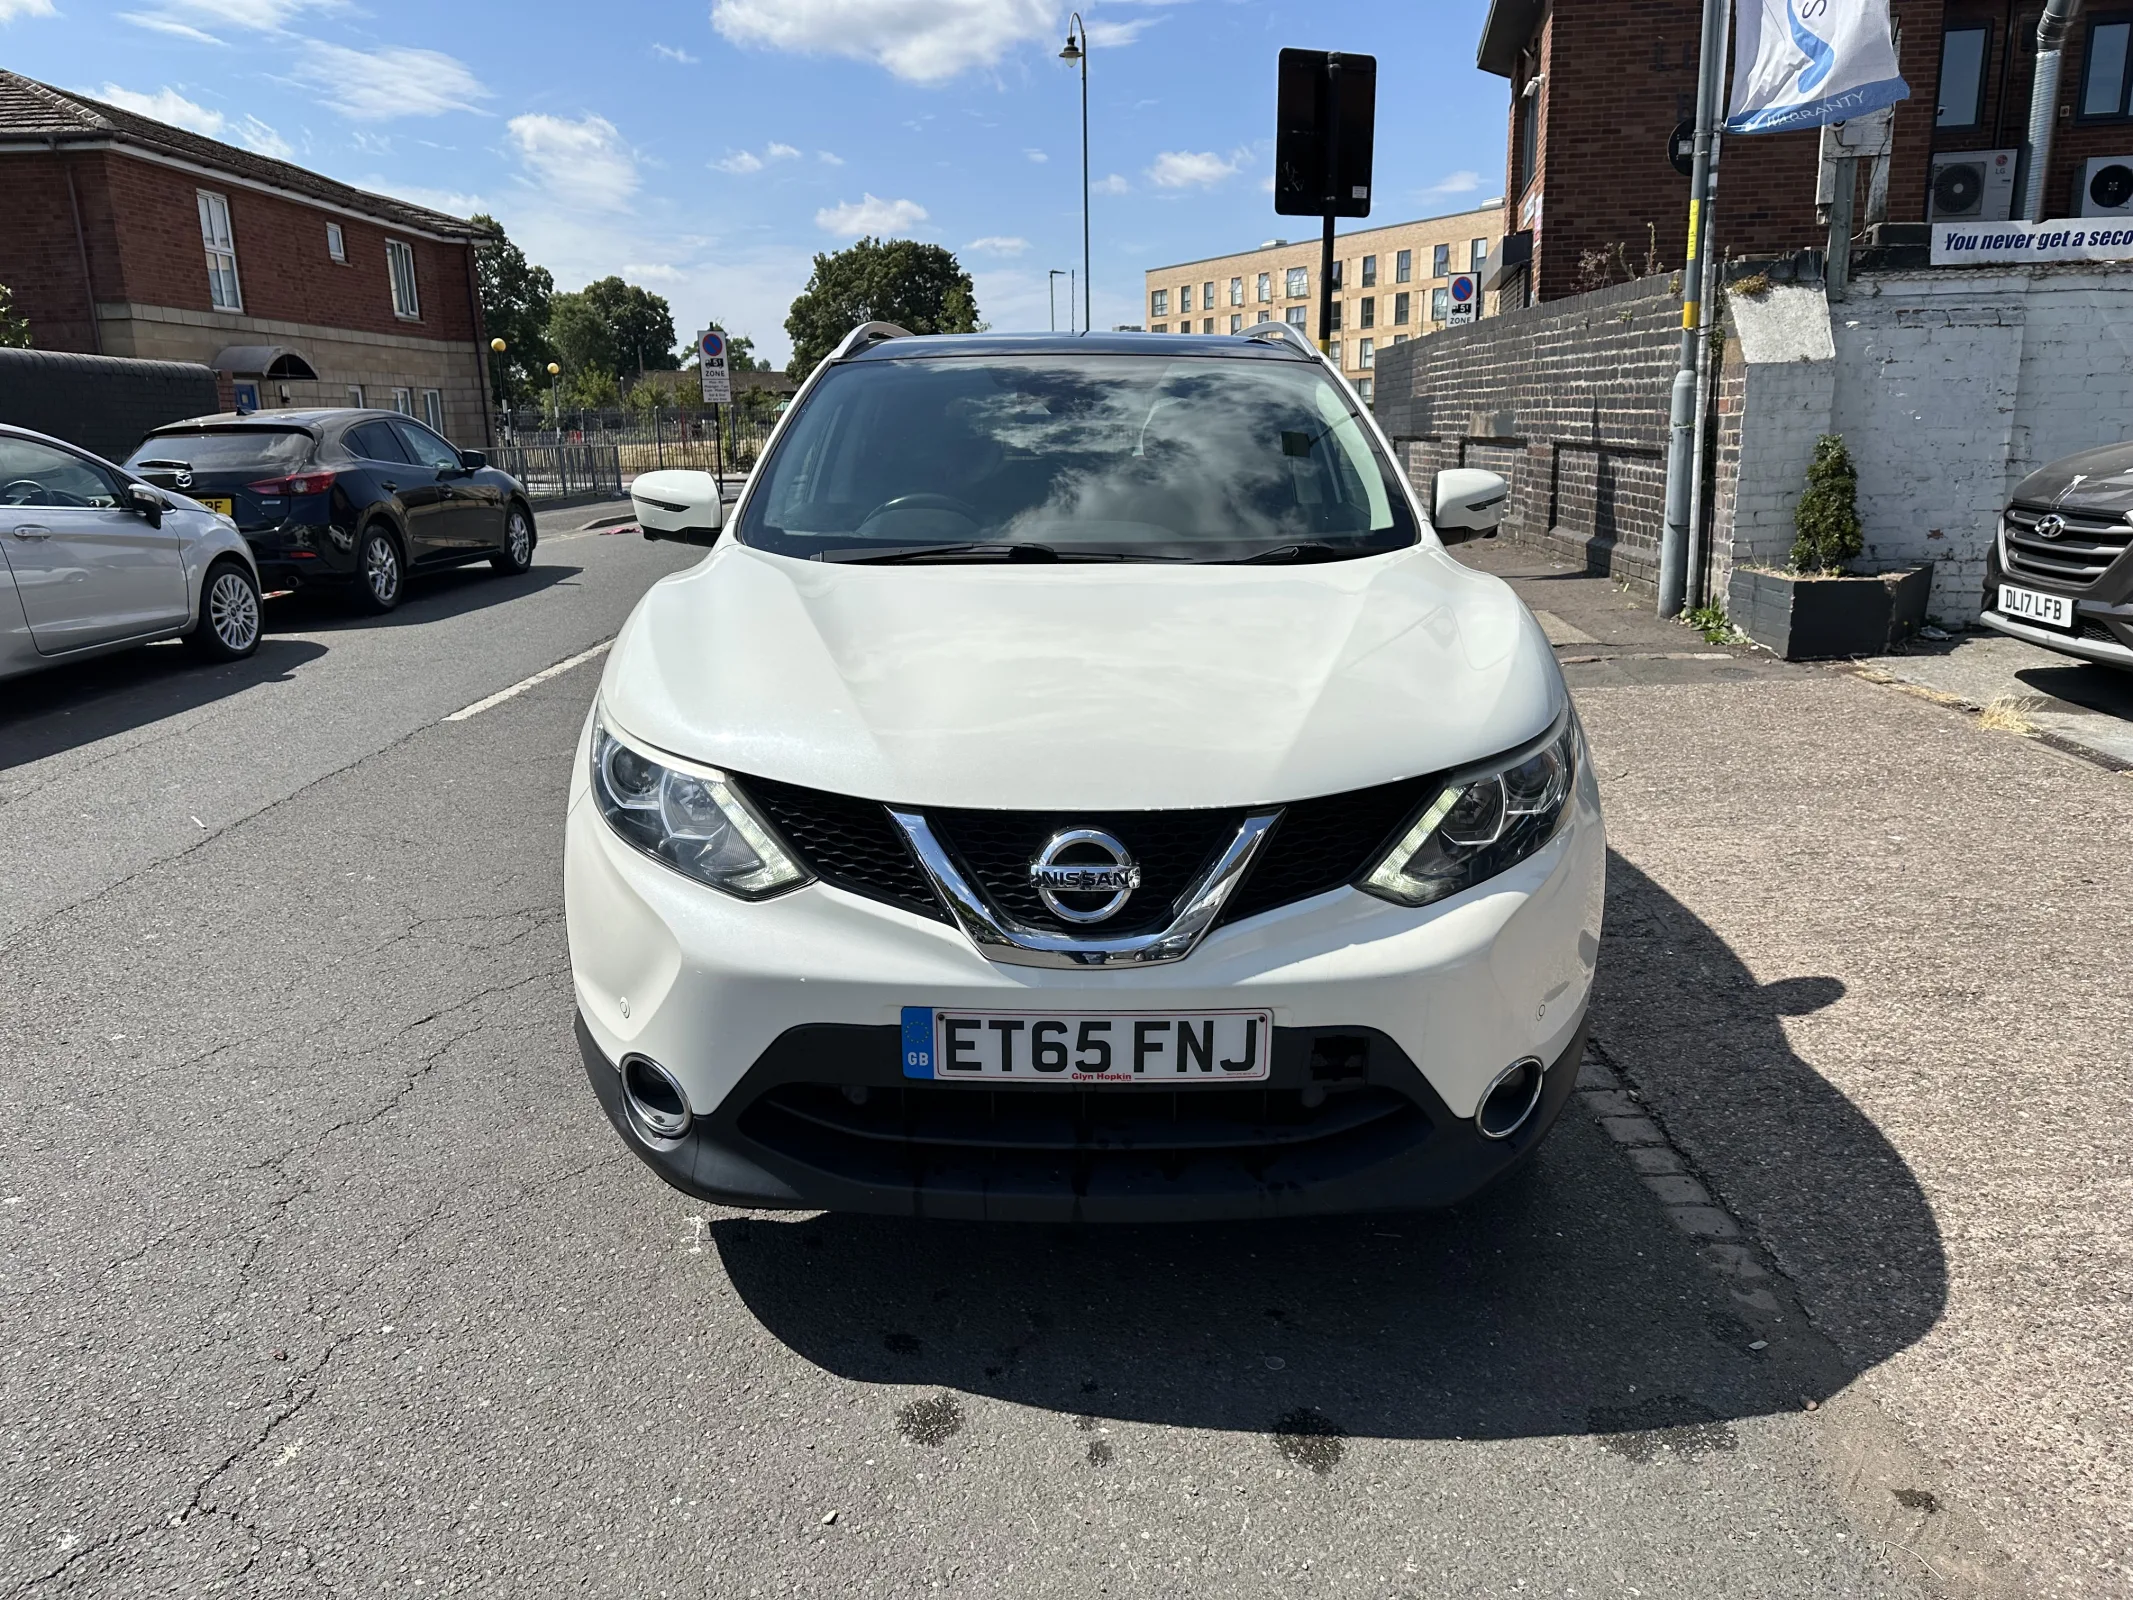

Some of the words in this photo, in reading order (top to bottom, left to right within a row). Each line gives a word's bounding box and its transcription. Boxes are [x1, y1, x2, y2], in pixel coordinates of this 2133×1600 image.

[1945, 233, 1978, 250] You
[1980, 233, 2036, 250] never
[2037, 230, 2071, 250] get
[2072, 231, 2086, 247] a
[2088, 230, 2133, 246] seco
[2005, 589, 2032, 613] DL17
[2035, 596, 2062, 620] LFB
[1041, 870, 1129, 887] NISSAN
[945, 1019, 1112, 1073] ET65
[1133, 1019, 1258, 1073] FNJ
[907, 1052, 929, 1066] GB
[1071, 1073, 1094, 1081] Glyn
[1096, 1073, 1132, 1081] Hopkin
